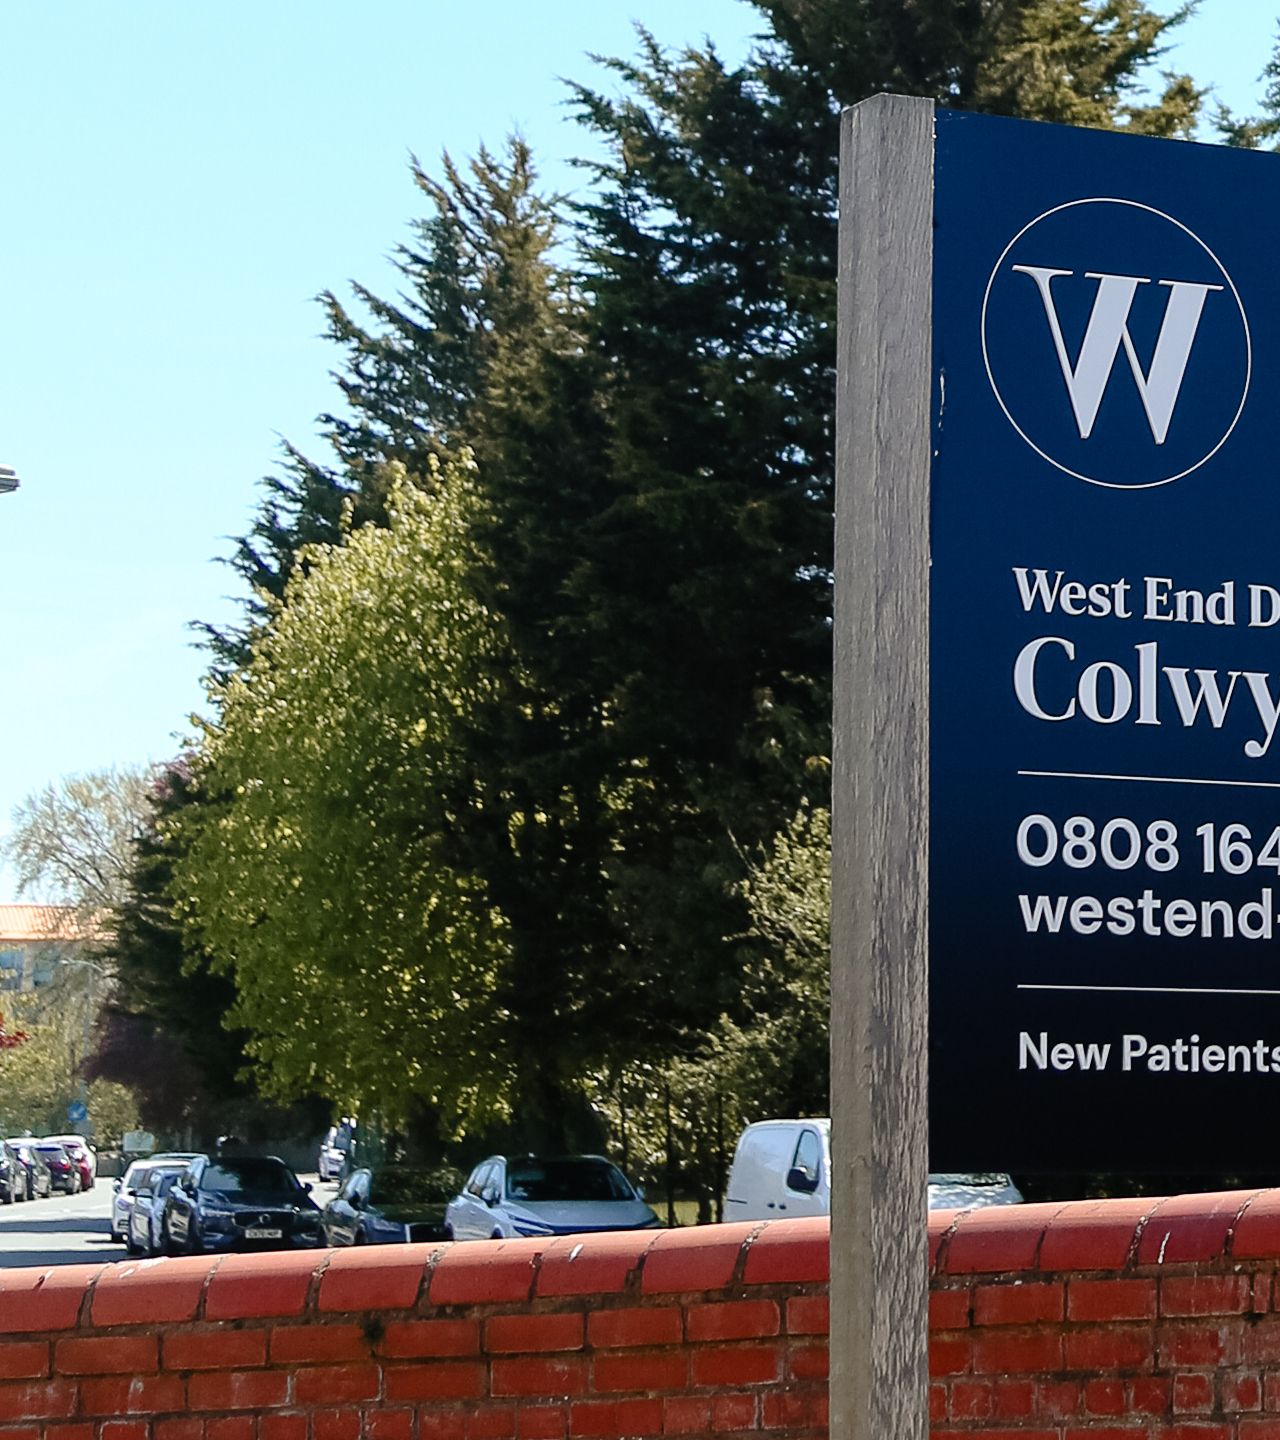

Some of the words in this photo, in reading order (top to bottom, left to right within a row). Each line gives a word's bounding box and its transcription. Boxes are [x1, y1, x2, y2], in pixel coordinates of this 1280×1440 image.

[1011, 263, 1225, 445] W
[1011, 567, 1133, 619] West
[1143, 576, 1236, 626] End
[1016, 814, 1180, 872] 0808
[1019, 1031, 1111, 1071] New
